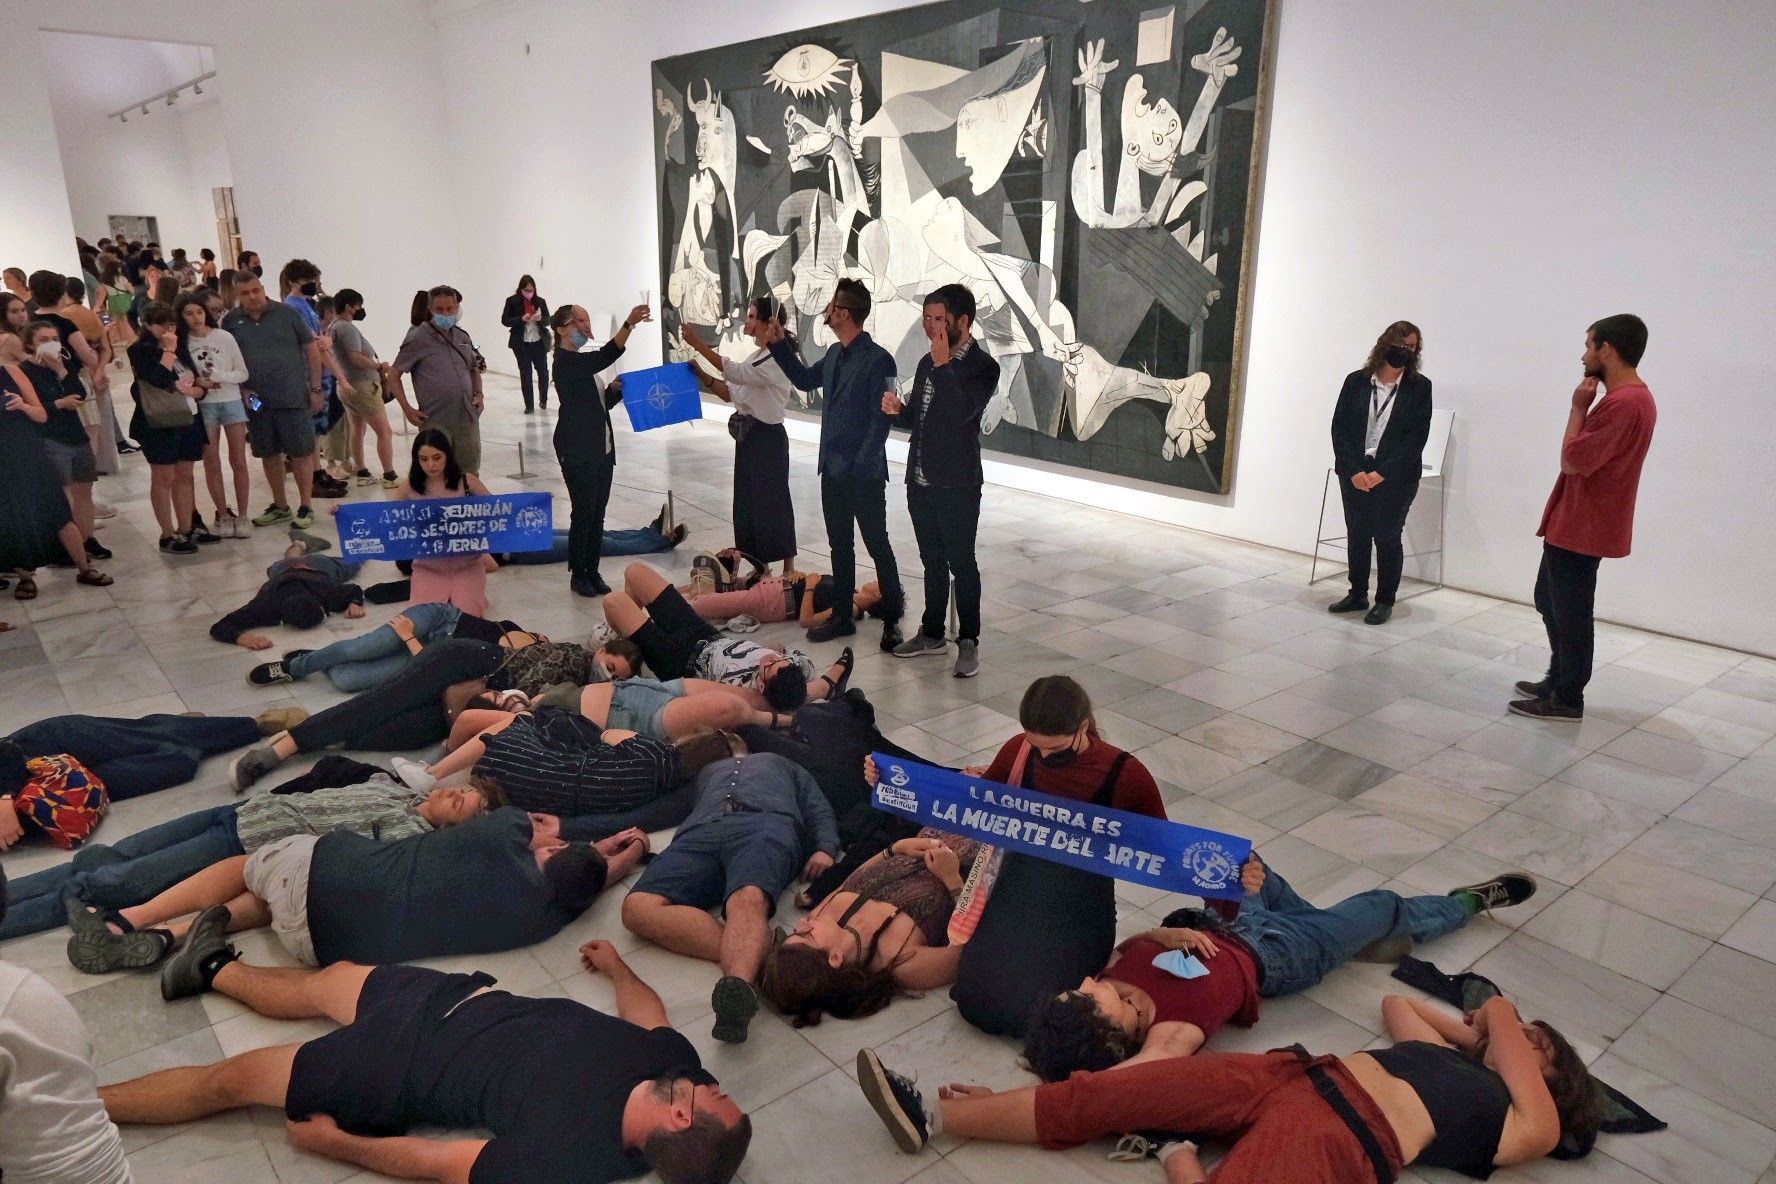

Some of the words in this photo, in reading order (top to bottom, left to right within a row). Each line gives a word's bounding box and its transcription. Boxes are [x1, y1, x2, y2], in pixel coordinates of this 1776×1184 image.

[389, 526, 417, 540] LOS
[489, 518, 507, 533] DE
[969, 786, 999, 806] LA
[1000, 795, 1086, 830] GUERRA
[1091, 816, 1121, 837] ES
[932, 800, 957, 824] LA
[961, 808, 1050, 846] MUERTE
[1050, 830, 1094, 858] DEL
[1104, 843, 1165, 876] ARTE
[965, 857, 984, 894] MASINO
[981, 843, 989, 855] RI
